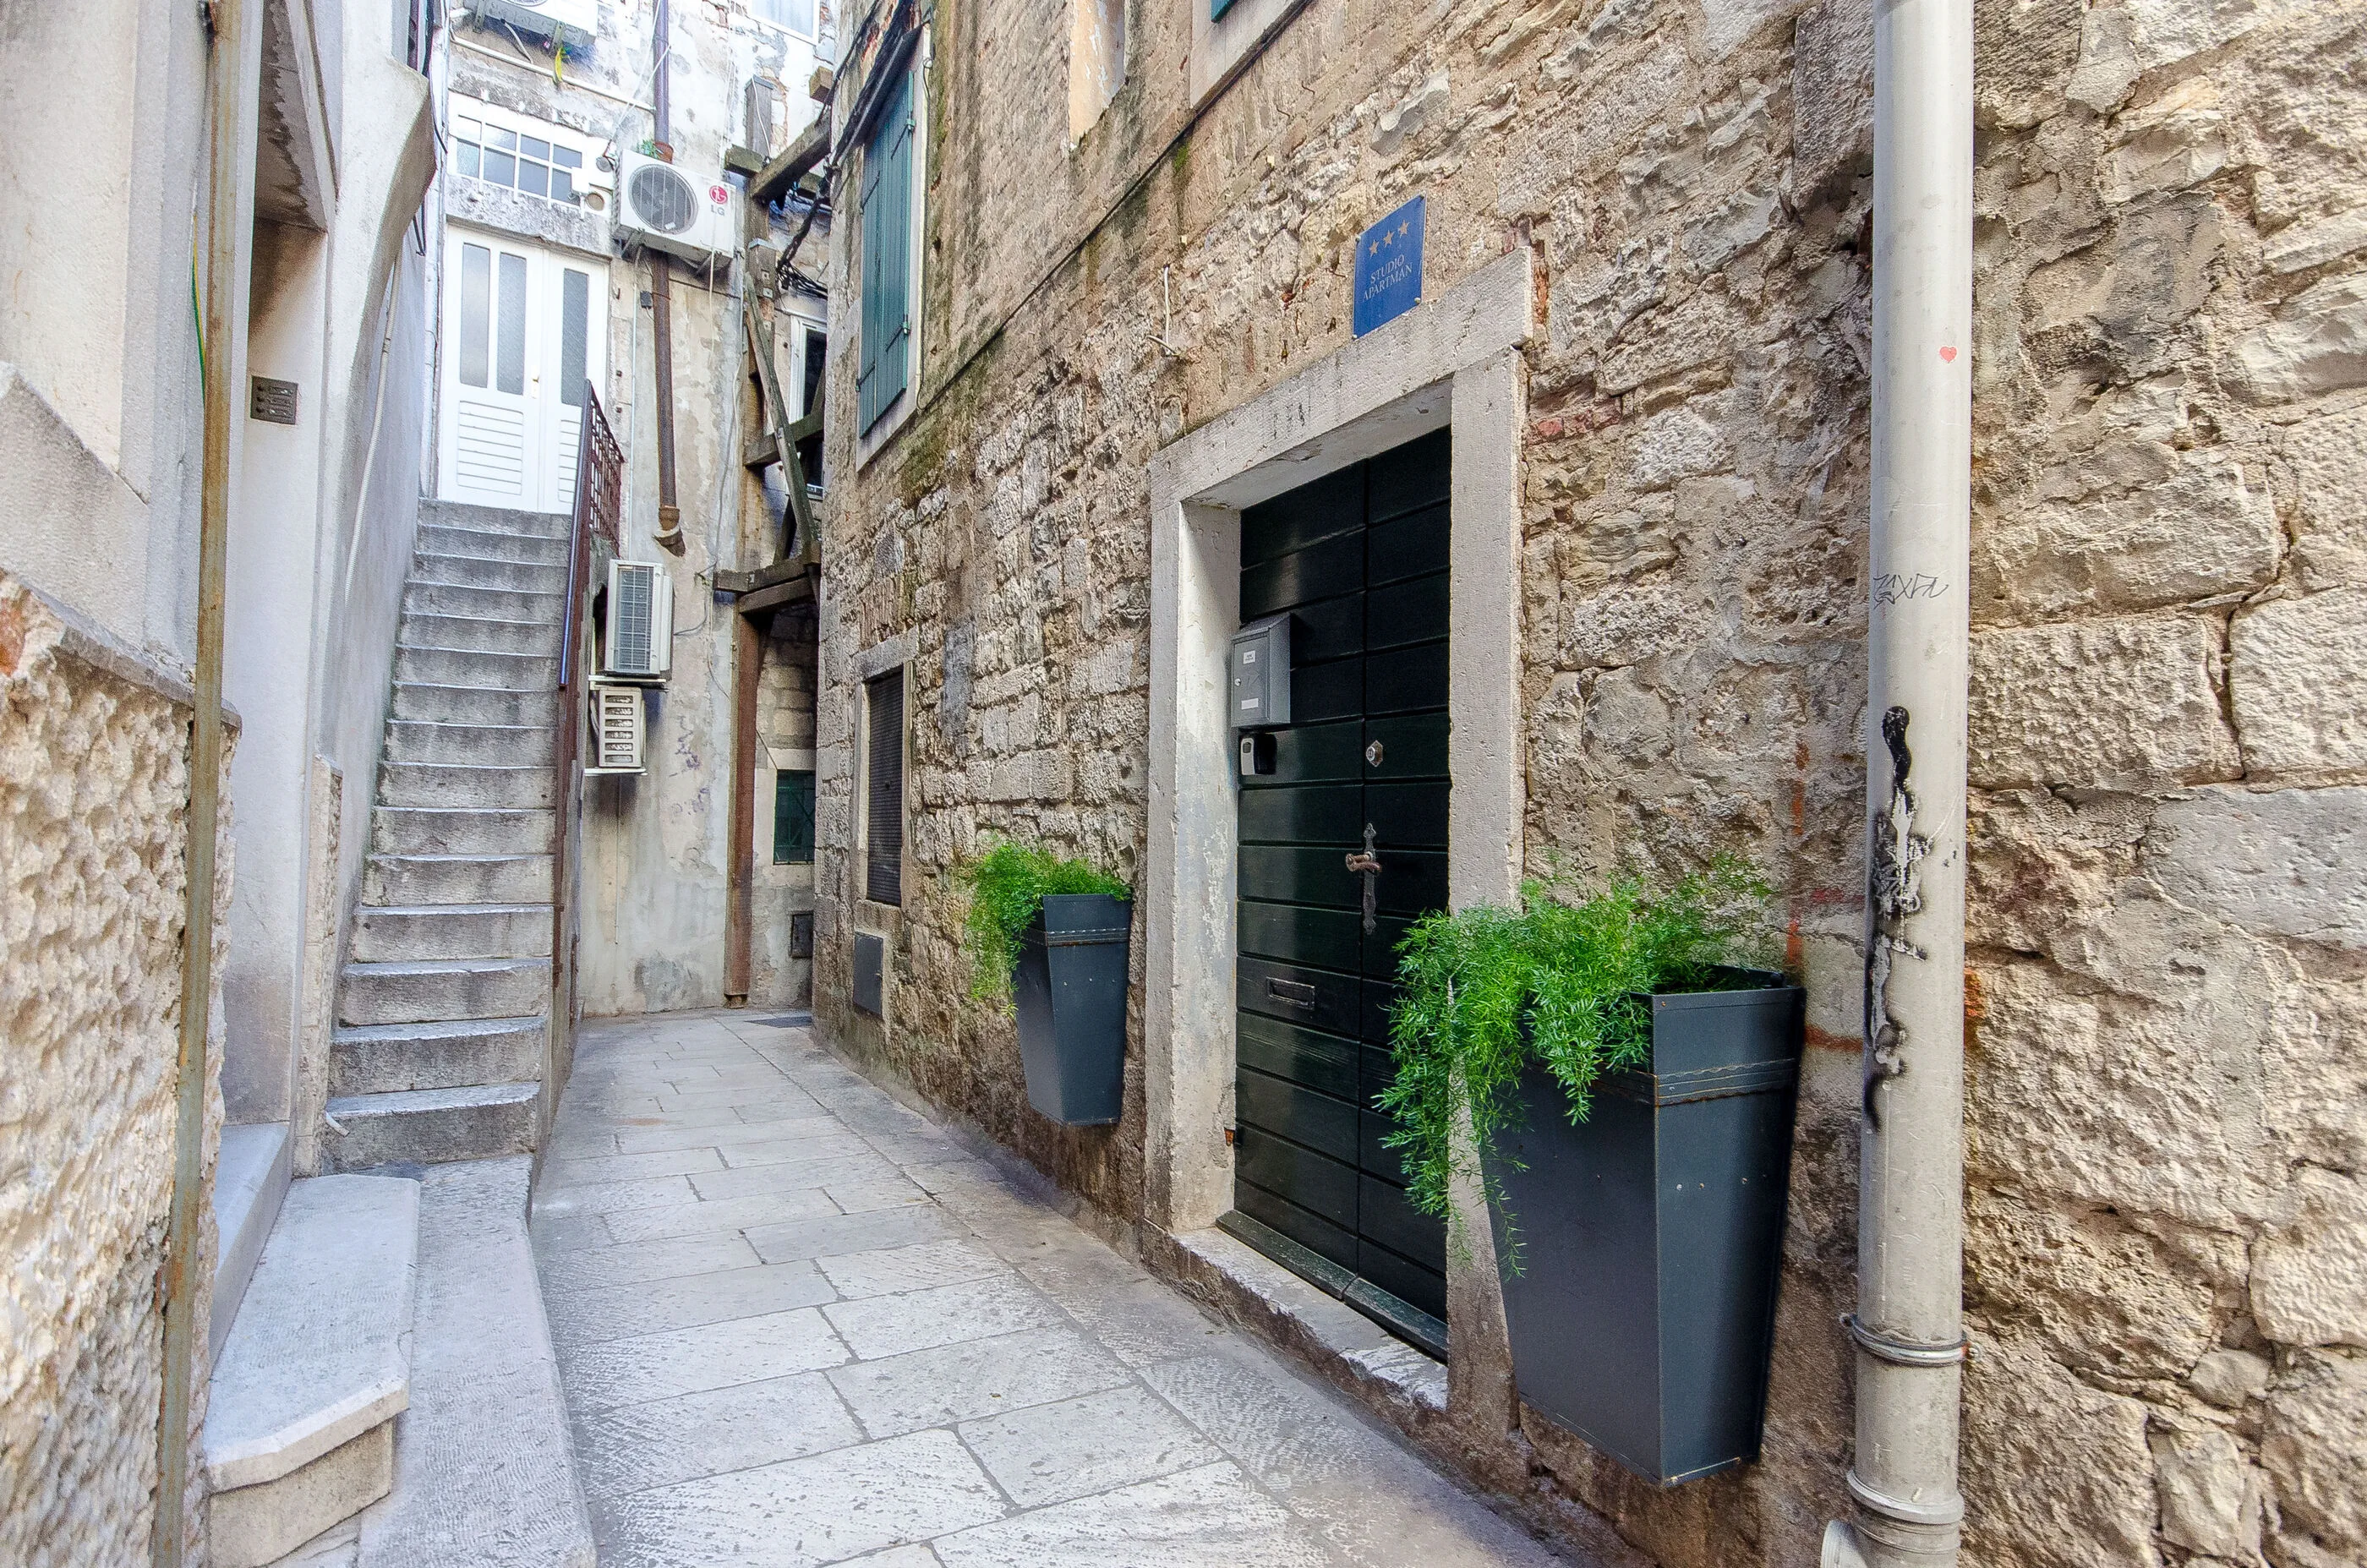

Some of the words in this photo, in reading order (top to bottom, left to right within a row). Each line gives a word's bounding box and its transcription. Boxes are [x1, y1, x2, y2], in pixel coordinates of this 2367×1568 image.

[711, 205, 724, 216] LG
[1363, 262, 1413, 302] APARTMAN
[1370, 254, 1405, 284] STUDIO
